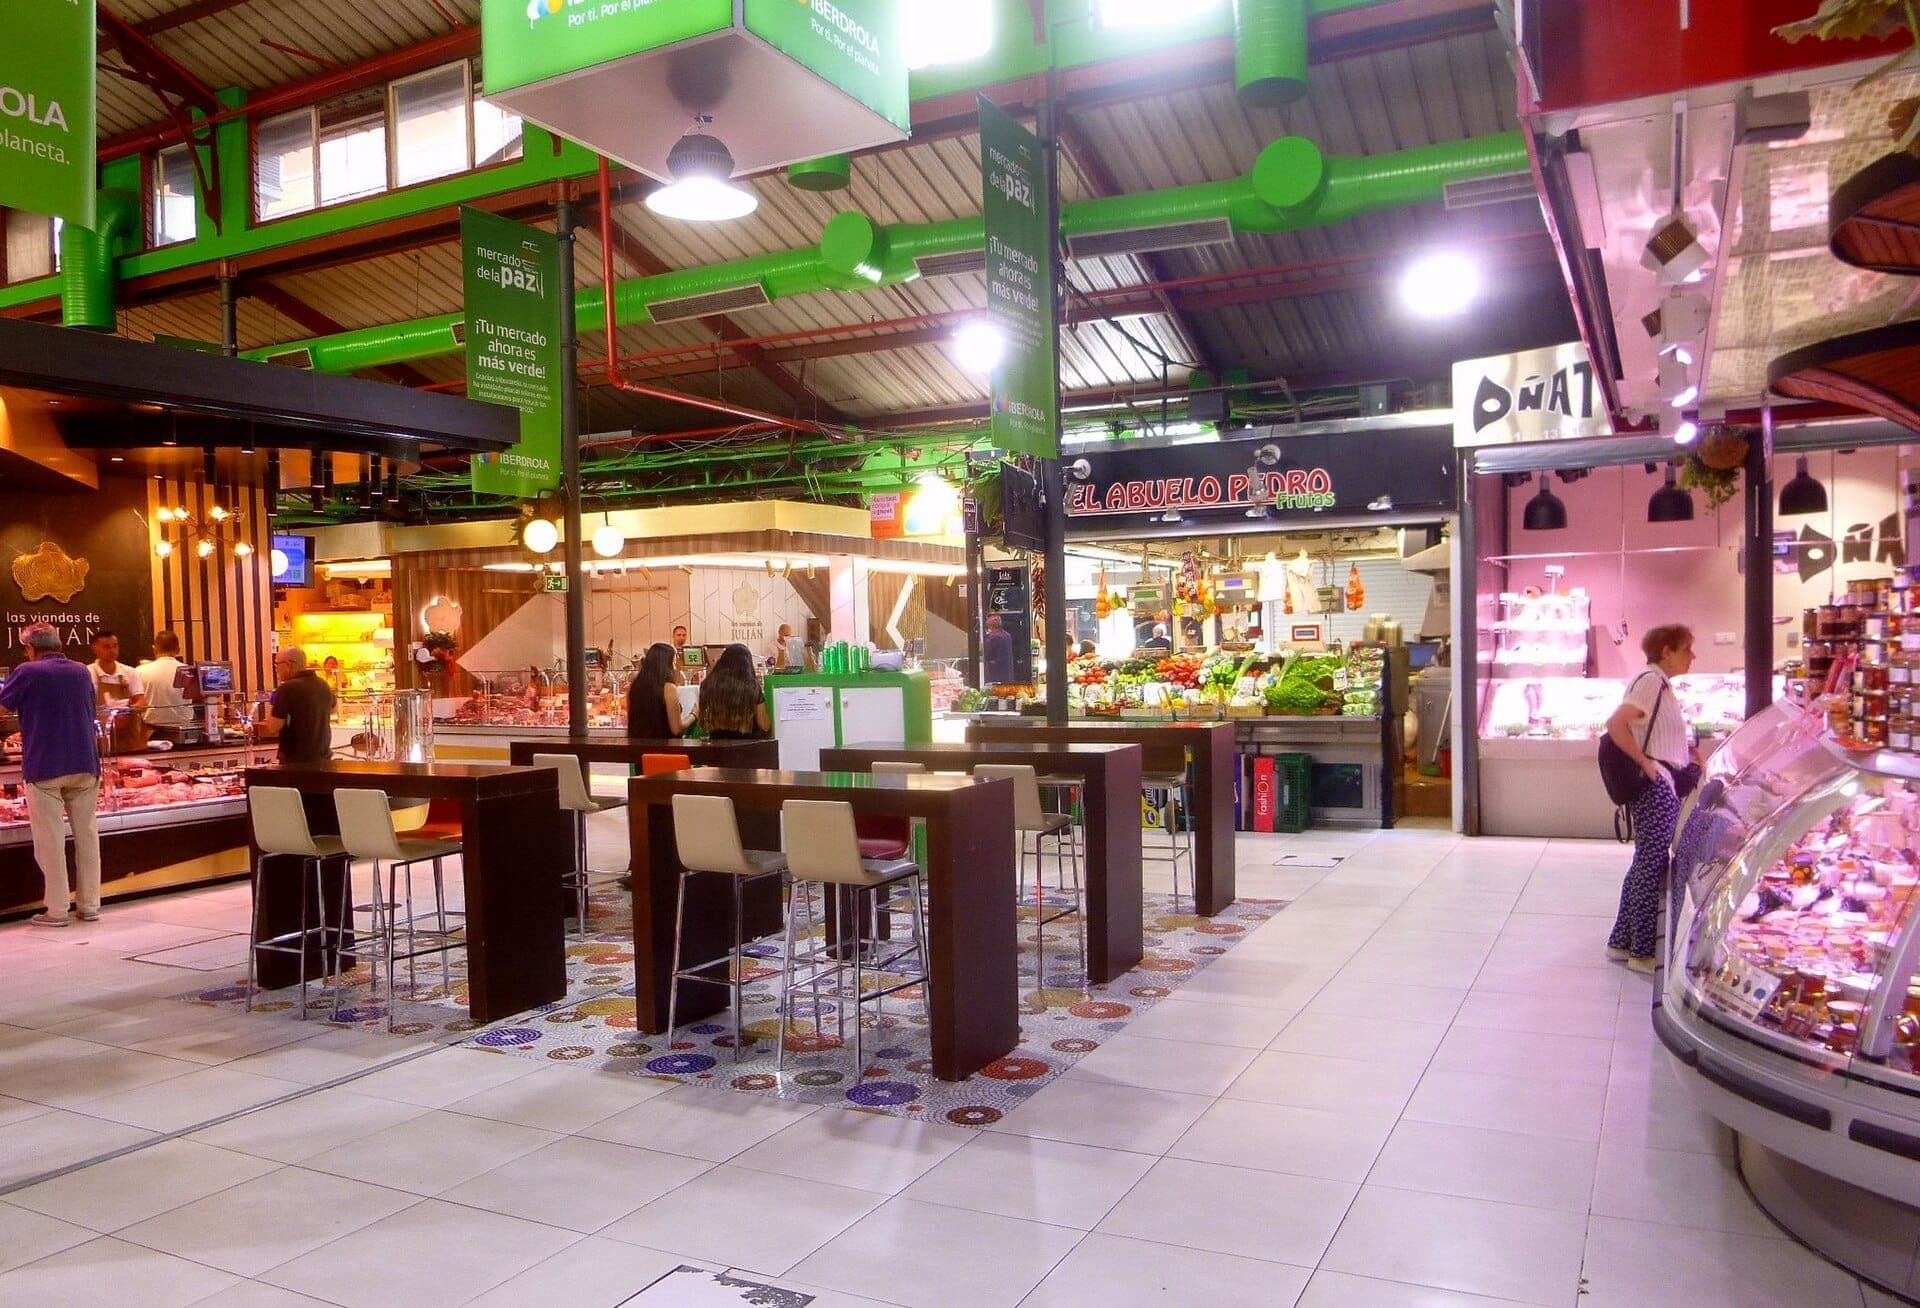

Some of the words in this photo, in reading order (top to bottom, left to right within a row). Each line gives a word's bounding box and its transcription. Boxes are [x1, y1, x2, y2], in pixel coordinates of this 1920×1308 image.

[568, 13, 585, 27] Por
[601, 3, 618, 17] Por
[811, 0, 880, 57] IBERDROLA
[988, 147, 1020, 176] mercado
[1006, 173, 1030, 209] paz
[477, 246, 521, 267] mercado
[1003, 245, 1038, 274] mercado
[477, 265, 491, 281] de
[492, 268, 500, 283] la
[501, 266, 537, 292] paz
[992, 280, 1010, 300] más
[475, 318, 494, 335] ¡Tu
[497, 325, 547, 347] mercado
[488, 338, 523, 358] ahora
[524, 348, 536, 361] es
[478, 355, 505, 371] más
[508, 361, 546, 379] verde!
[500, 453, 550, 470] IBERDROLA
[1072, 484, 1101, 510] EL
[1105, 475, 1221, 510] ABUELO
[1228, 468, 1332, 503] PDRO
[1276, 490, 1336, 510] Frutas
[7, 611, 26, 623] las
[30, 611, 81, 624] viandas
[85, 612, 100, 623] de
